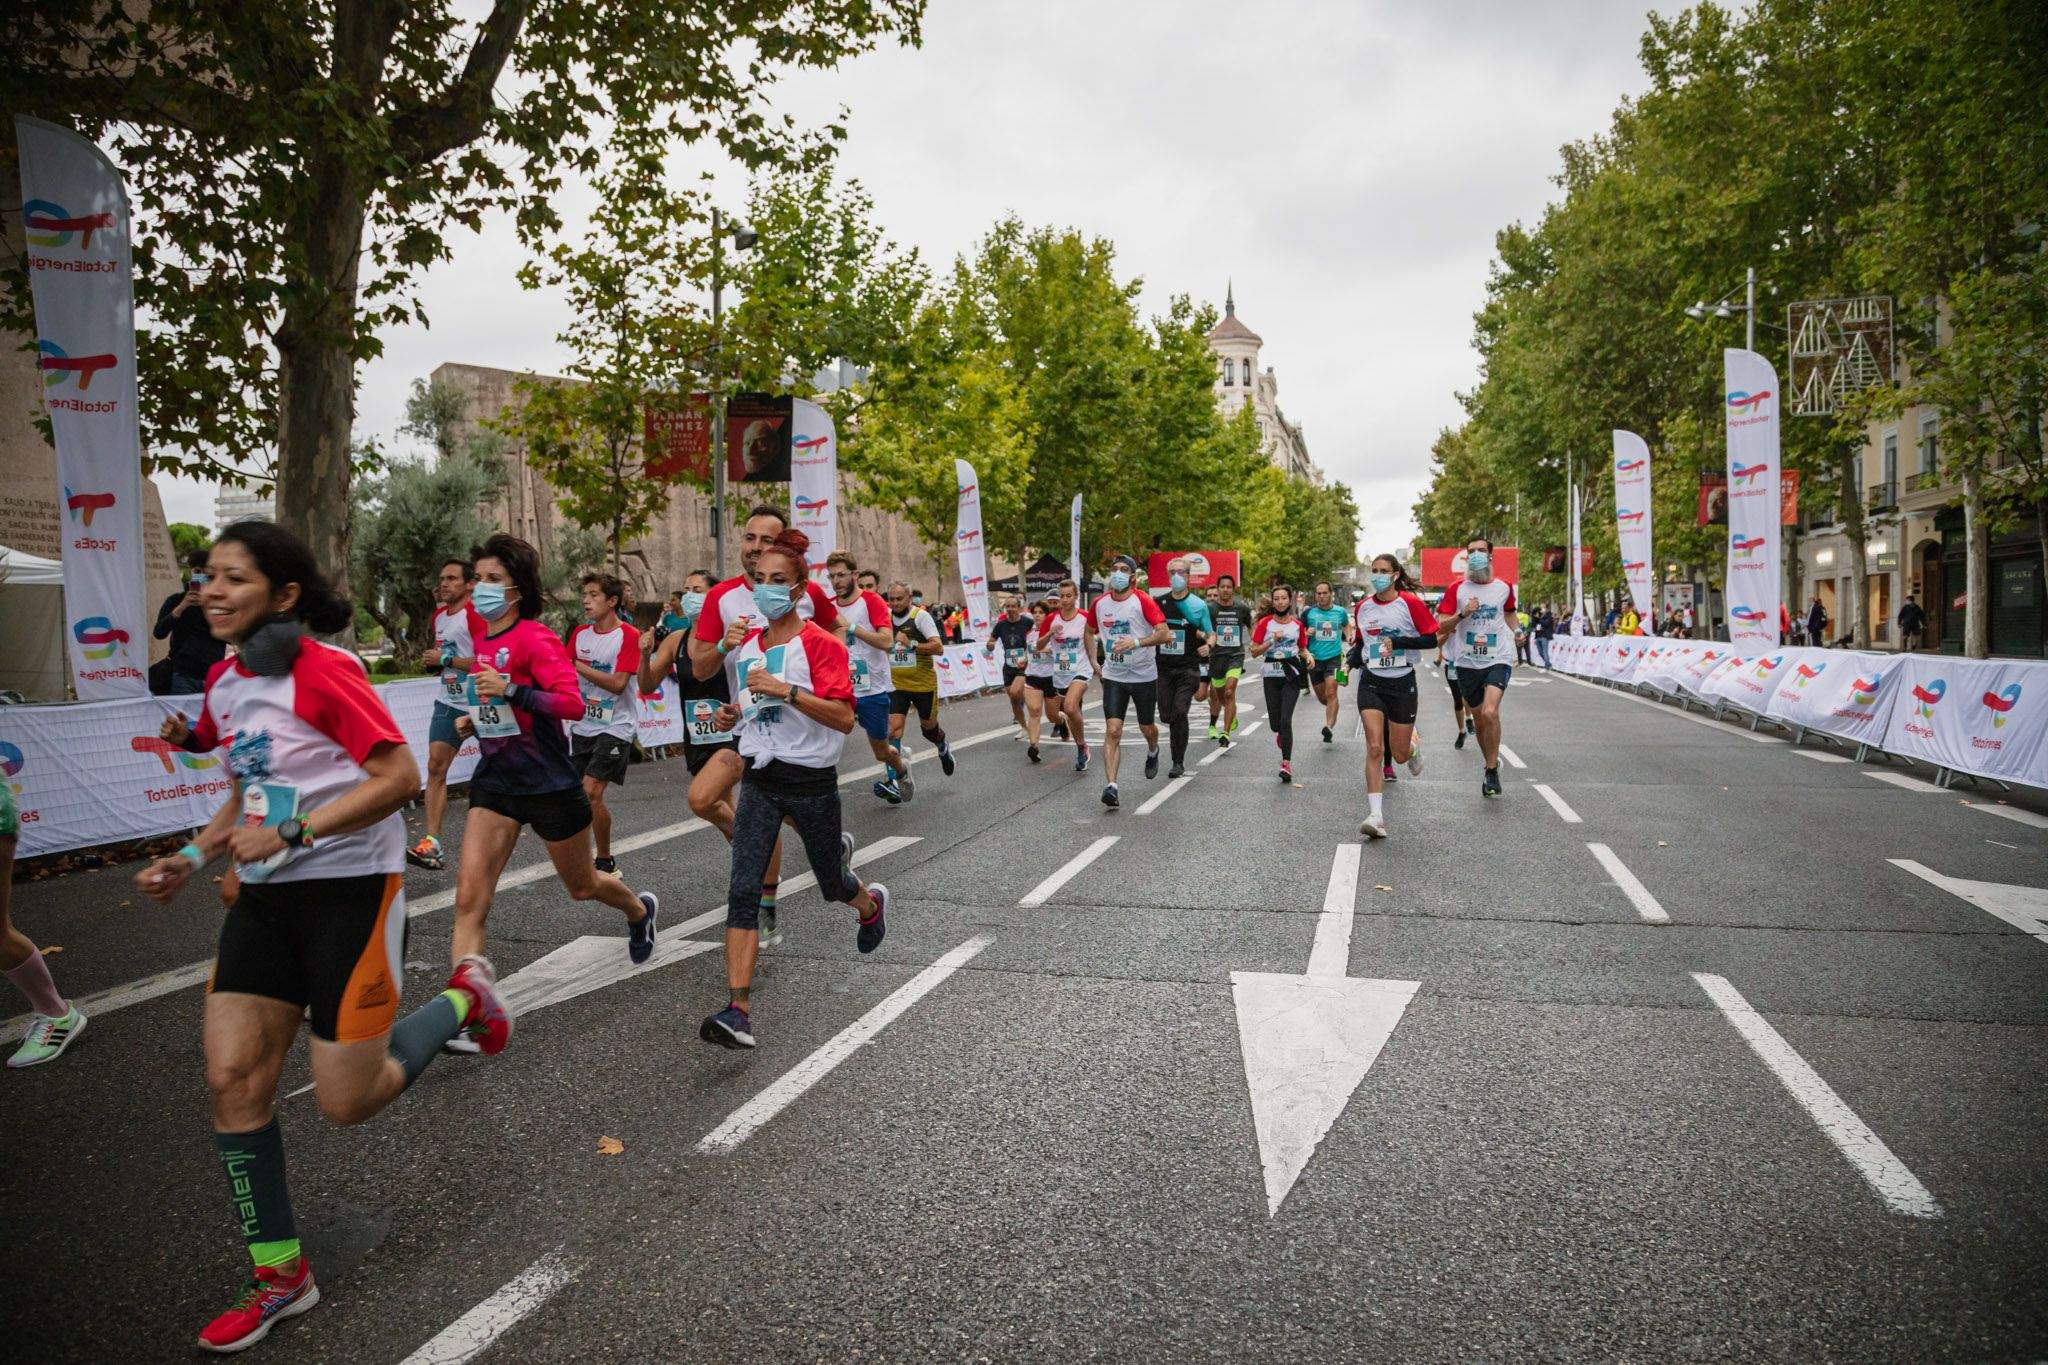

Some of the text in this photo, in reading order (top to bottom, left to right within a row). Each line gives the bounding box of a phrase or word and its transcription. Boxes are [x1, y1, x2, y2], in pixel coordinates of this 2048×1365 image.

[1473, 645, 1488, 656] 518
[1379, 657, 1395, 667] 467
[144, 778, 234, 804] TotalEnergies
